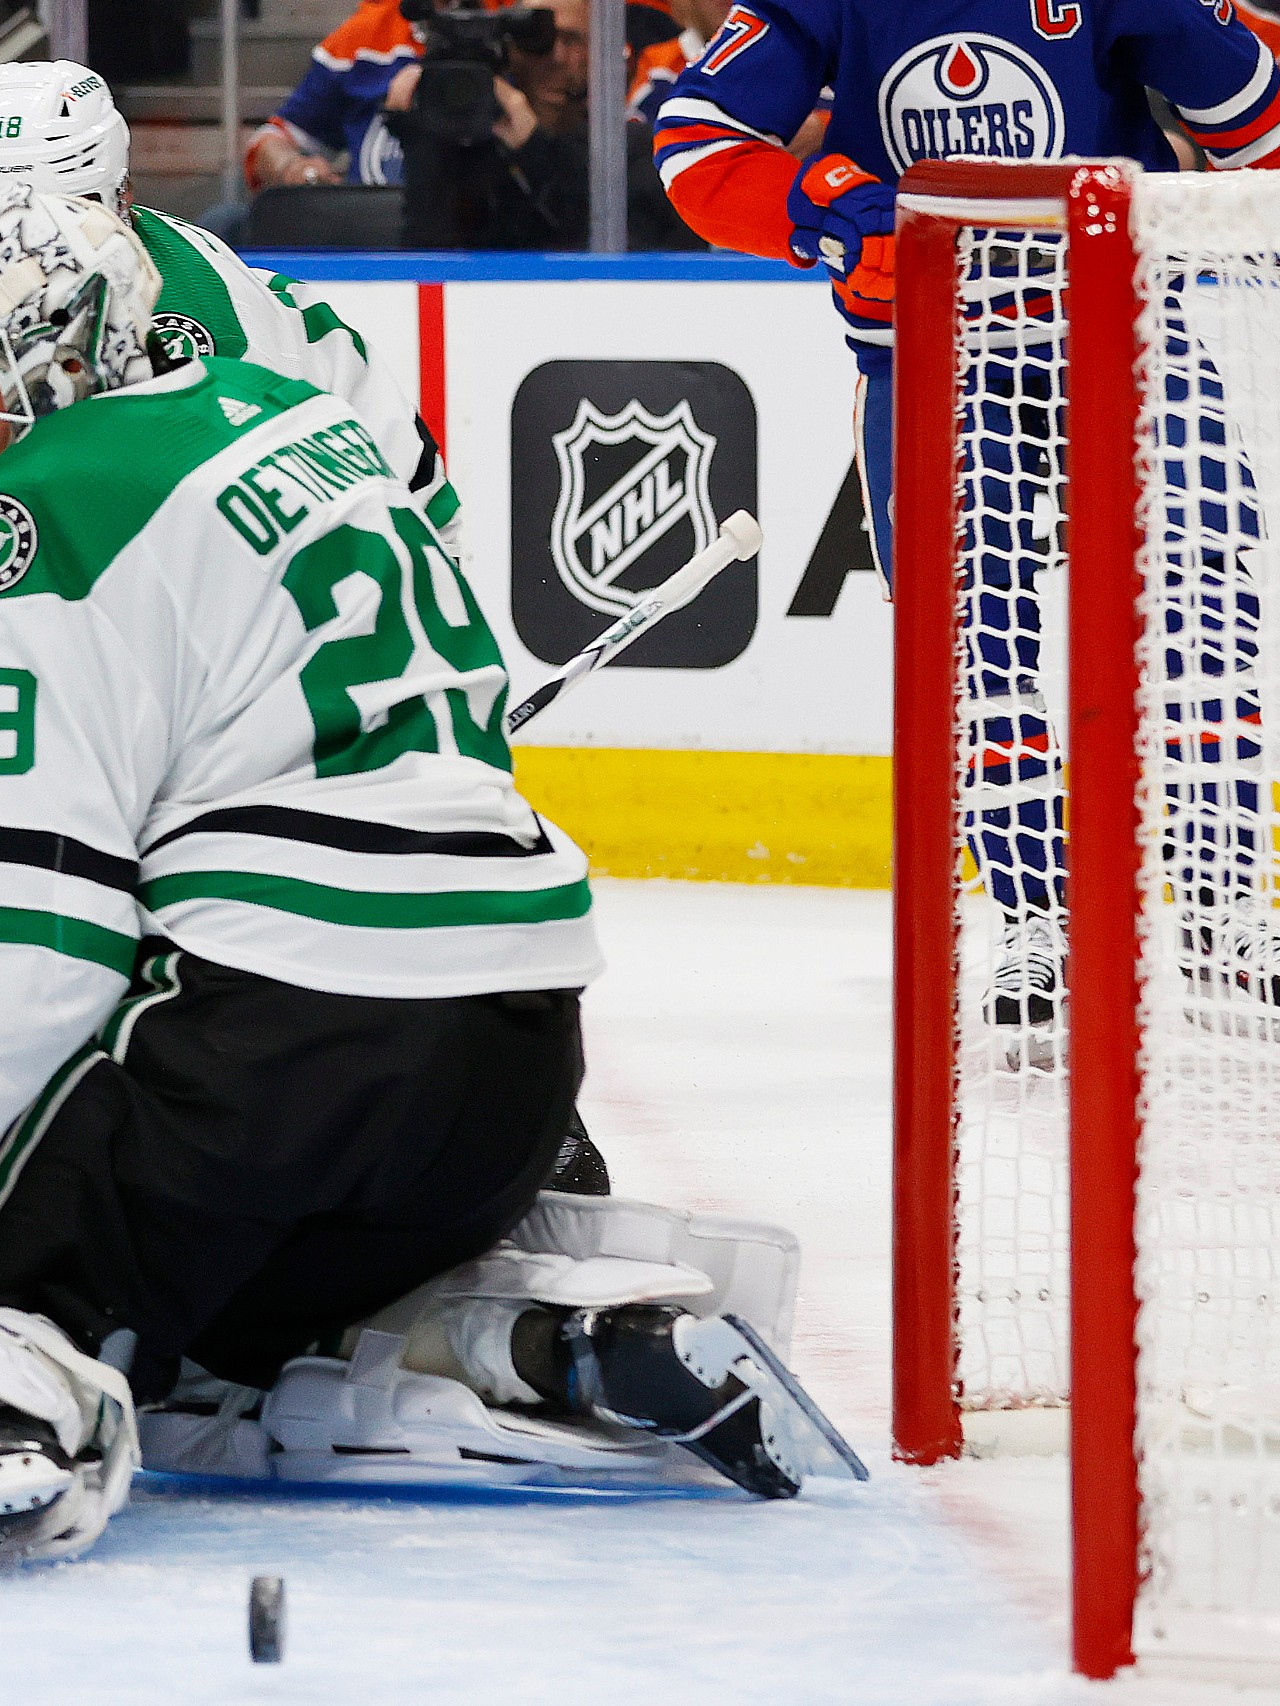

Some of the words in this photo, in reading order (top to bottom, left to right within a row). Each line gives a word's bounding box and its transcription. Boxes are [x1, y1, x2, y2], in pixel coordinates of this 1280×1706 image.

[901, 99, 1035, 159] OILERS
[588, 458, 685, 574] NHL
[281, 506, 513, 780] 29
